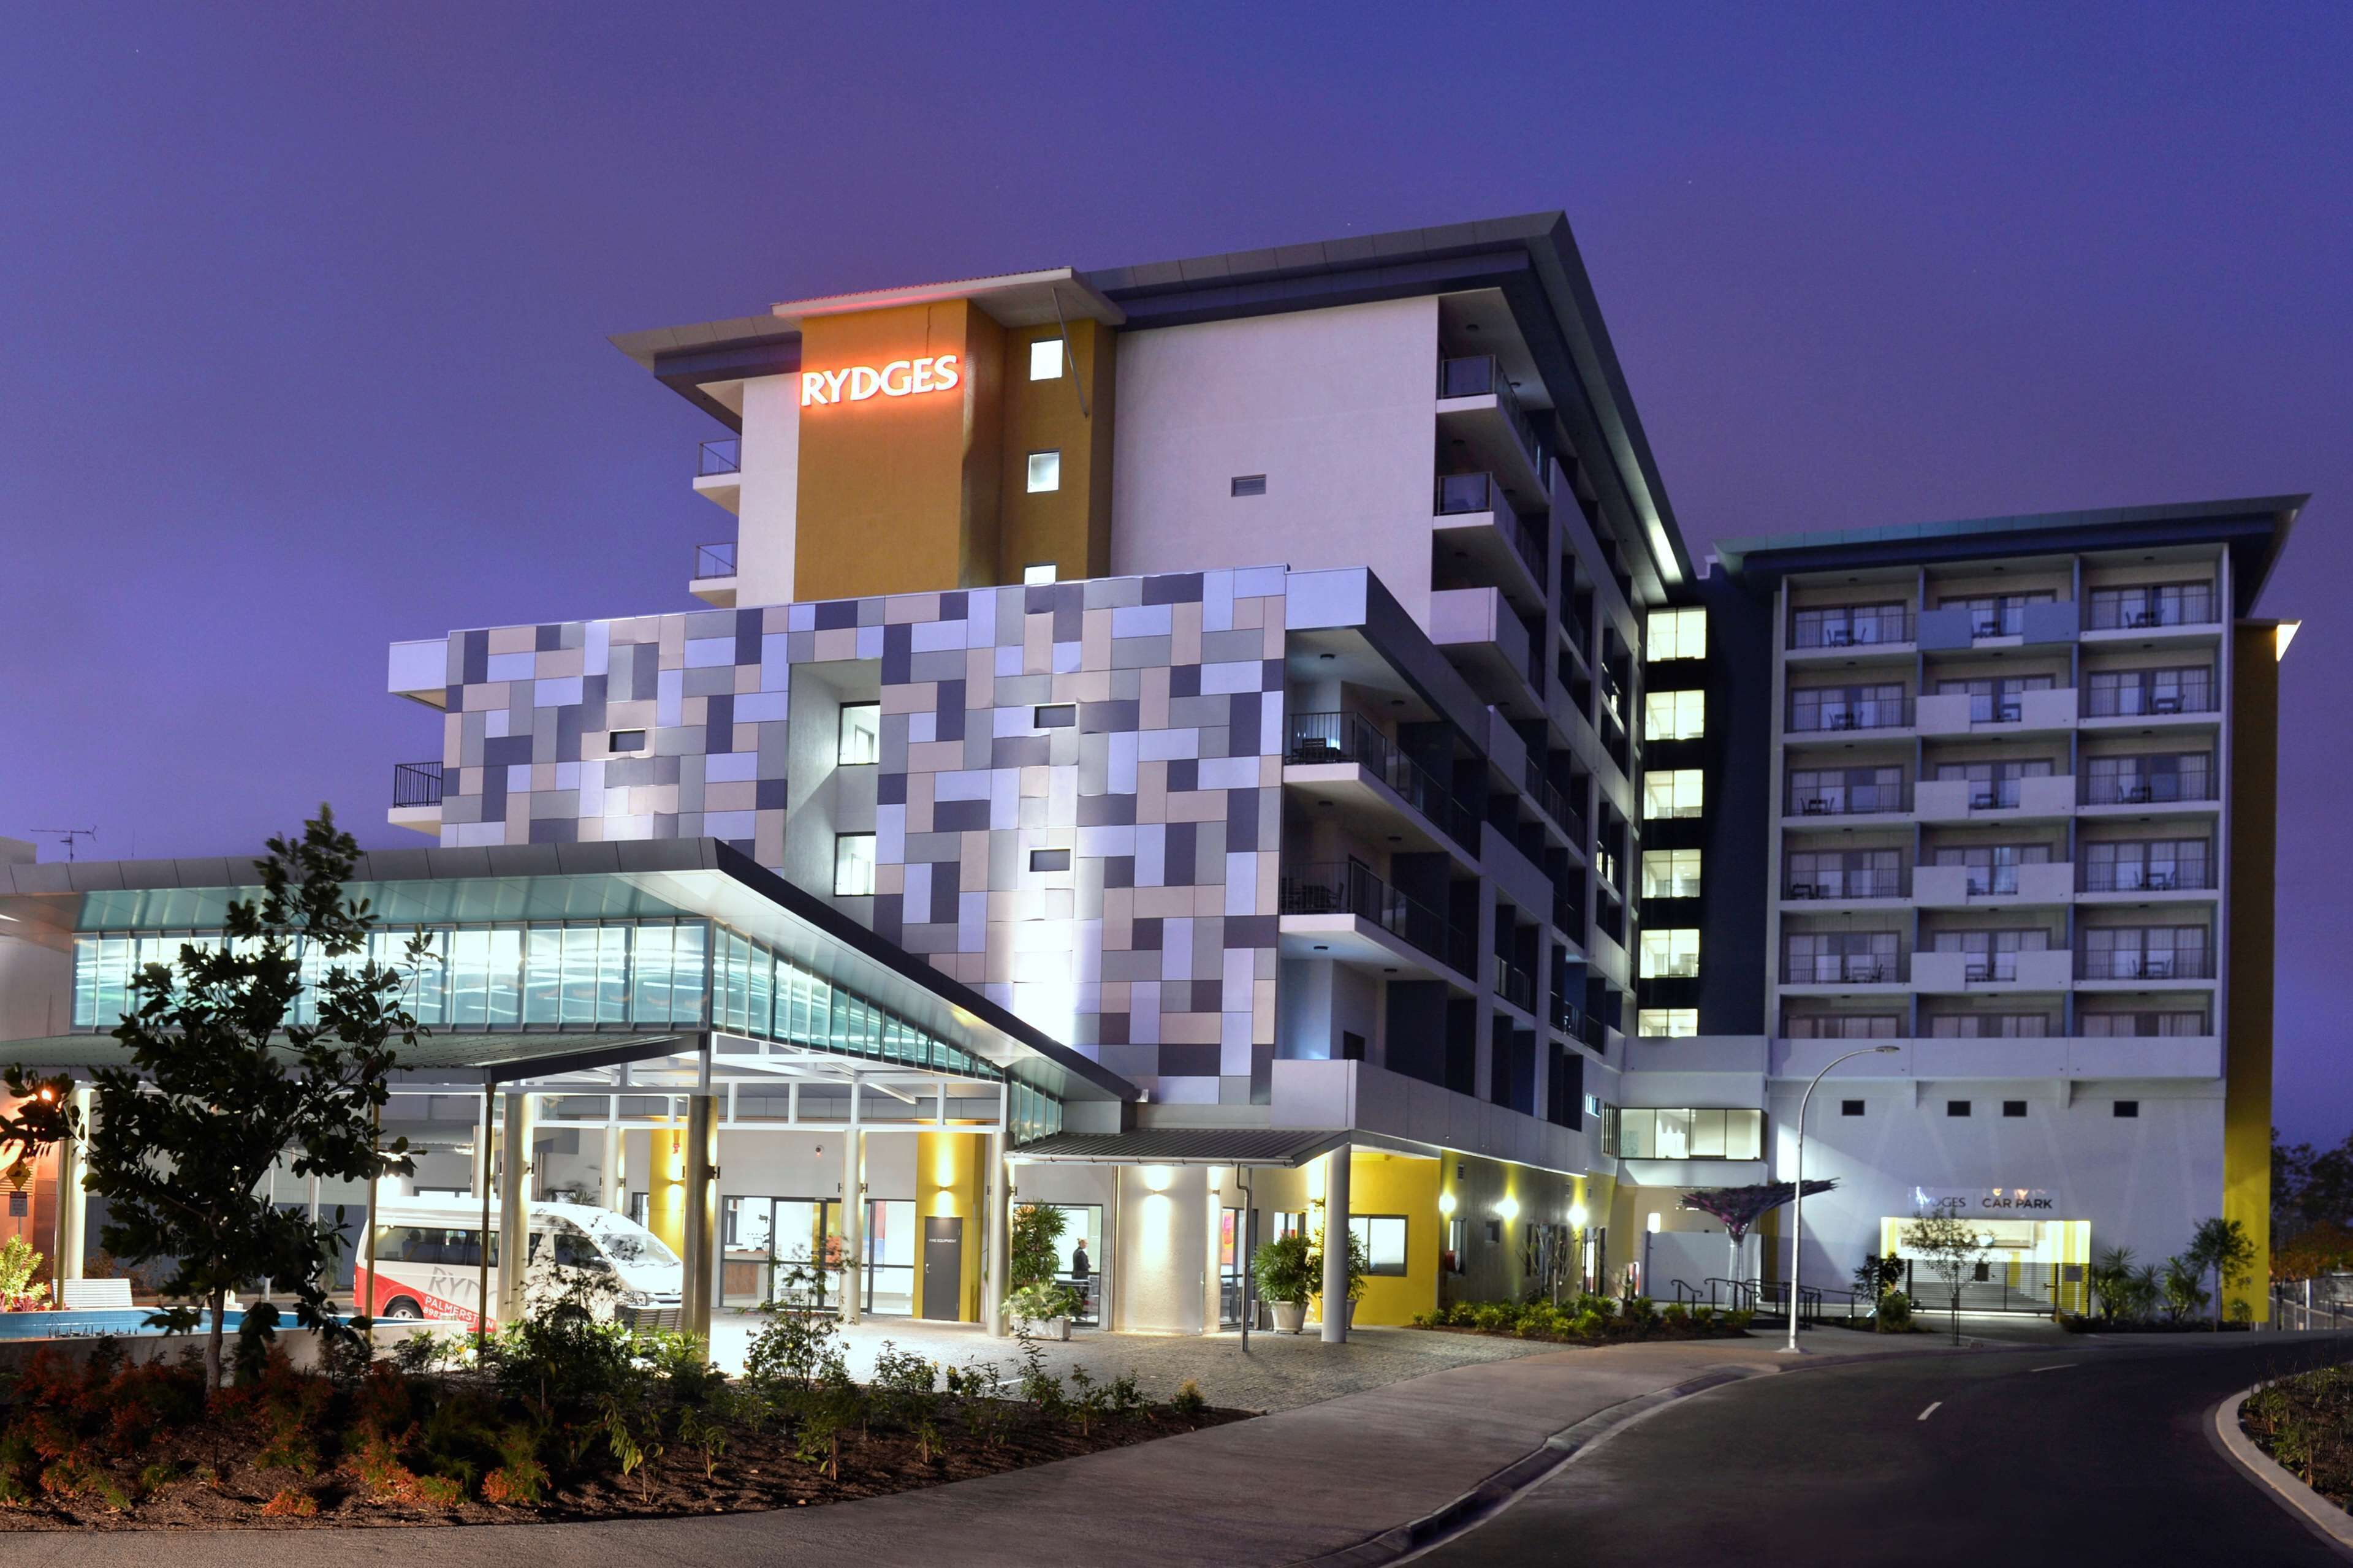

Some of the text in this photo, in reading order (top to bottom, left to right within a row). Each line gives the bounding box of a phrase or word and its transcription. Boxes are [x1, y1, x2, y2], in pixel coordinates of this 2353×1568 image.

[800, 355, 959, 406] RYDGES
[1982, 1198, 2012, 1208] CAR
[2016, 1198, 2053, 1209] PARK
[424, 1295, 494, 1329] PALMERSTN
